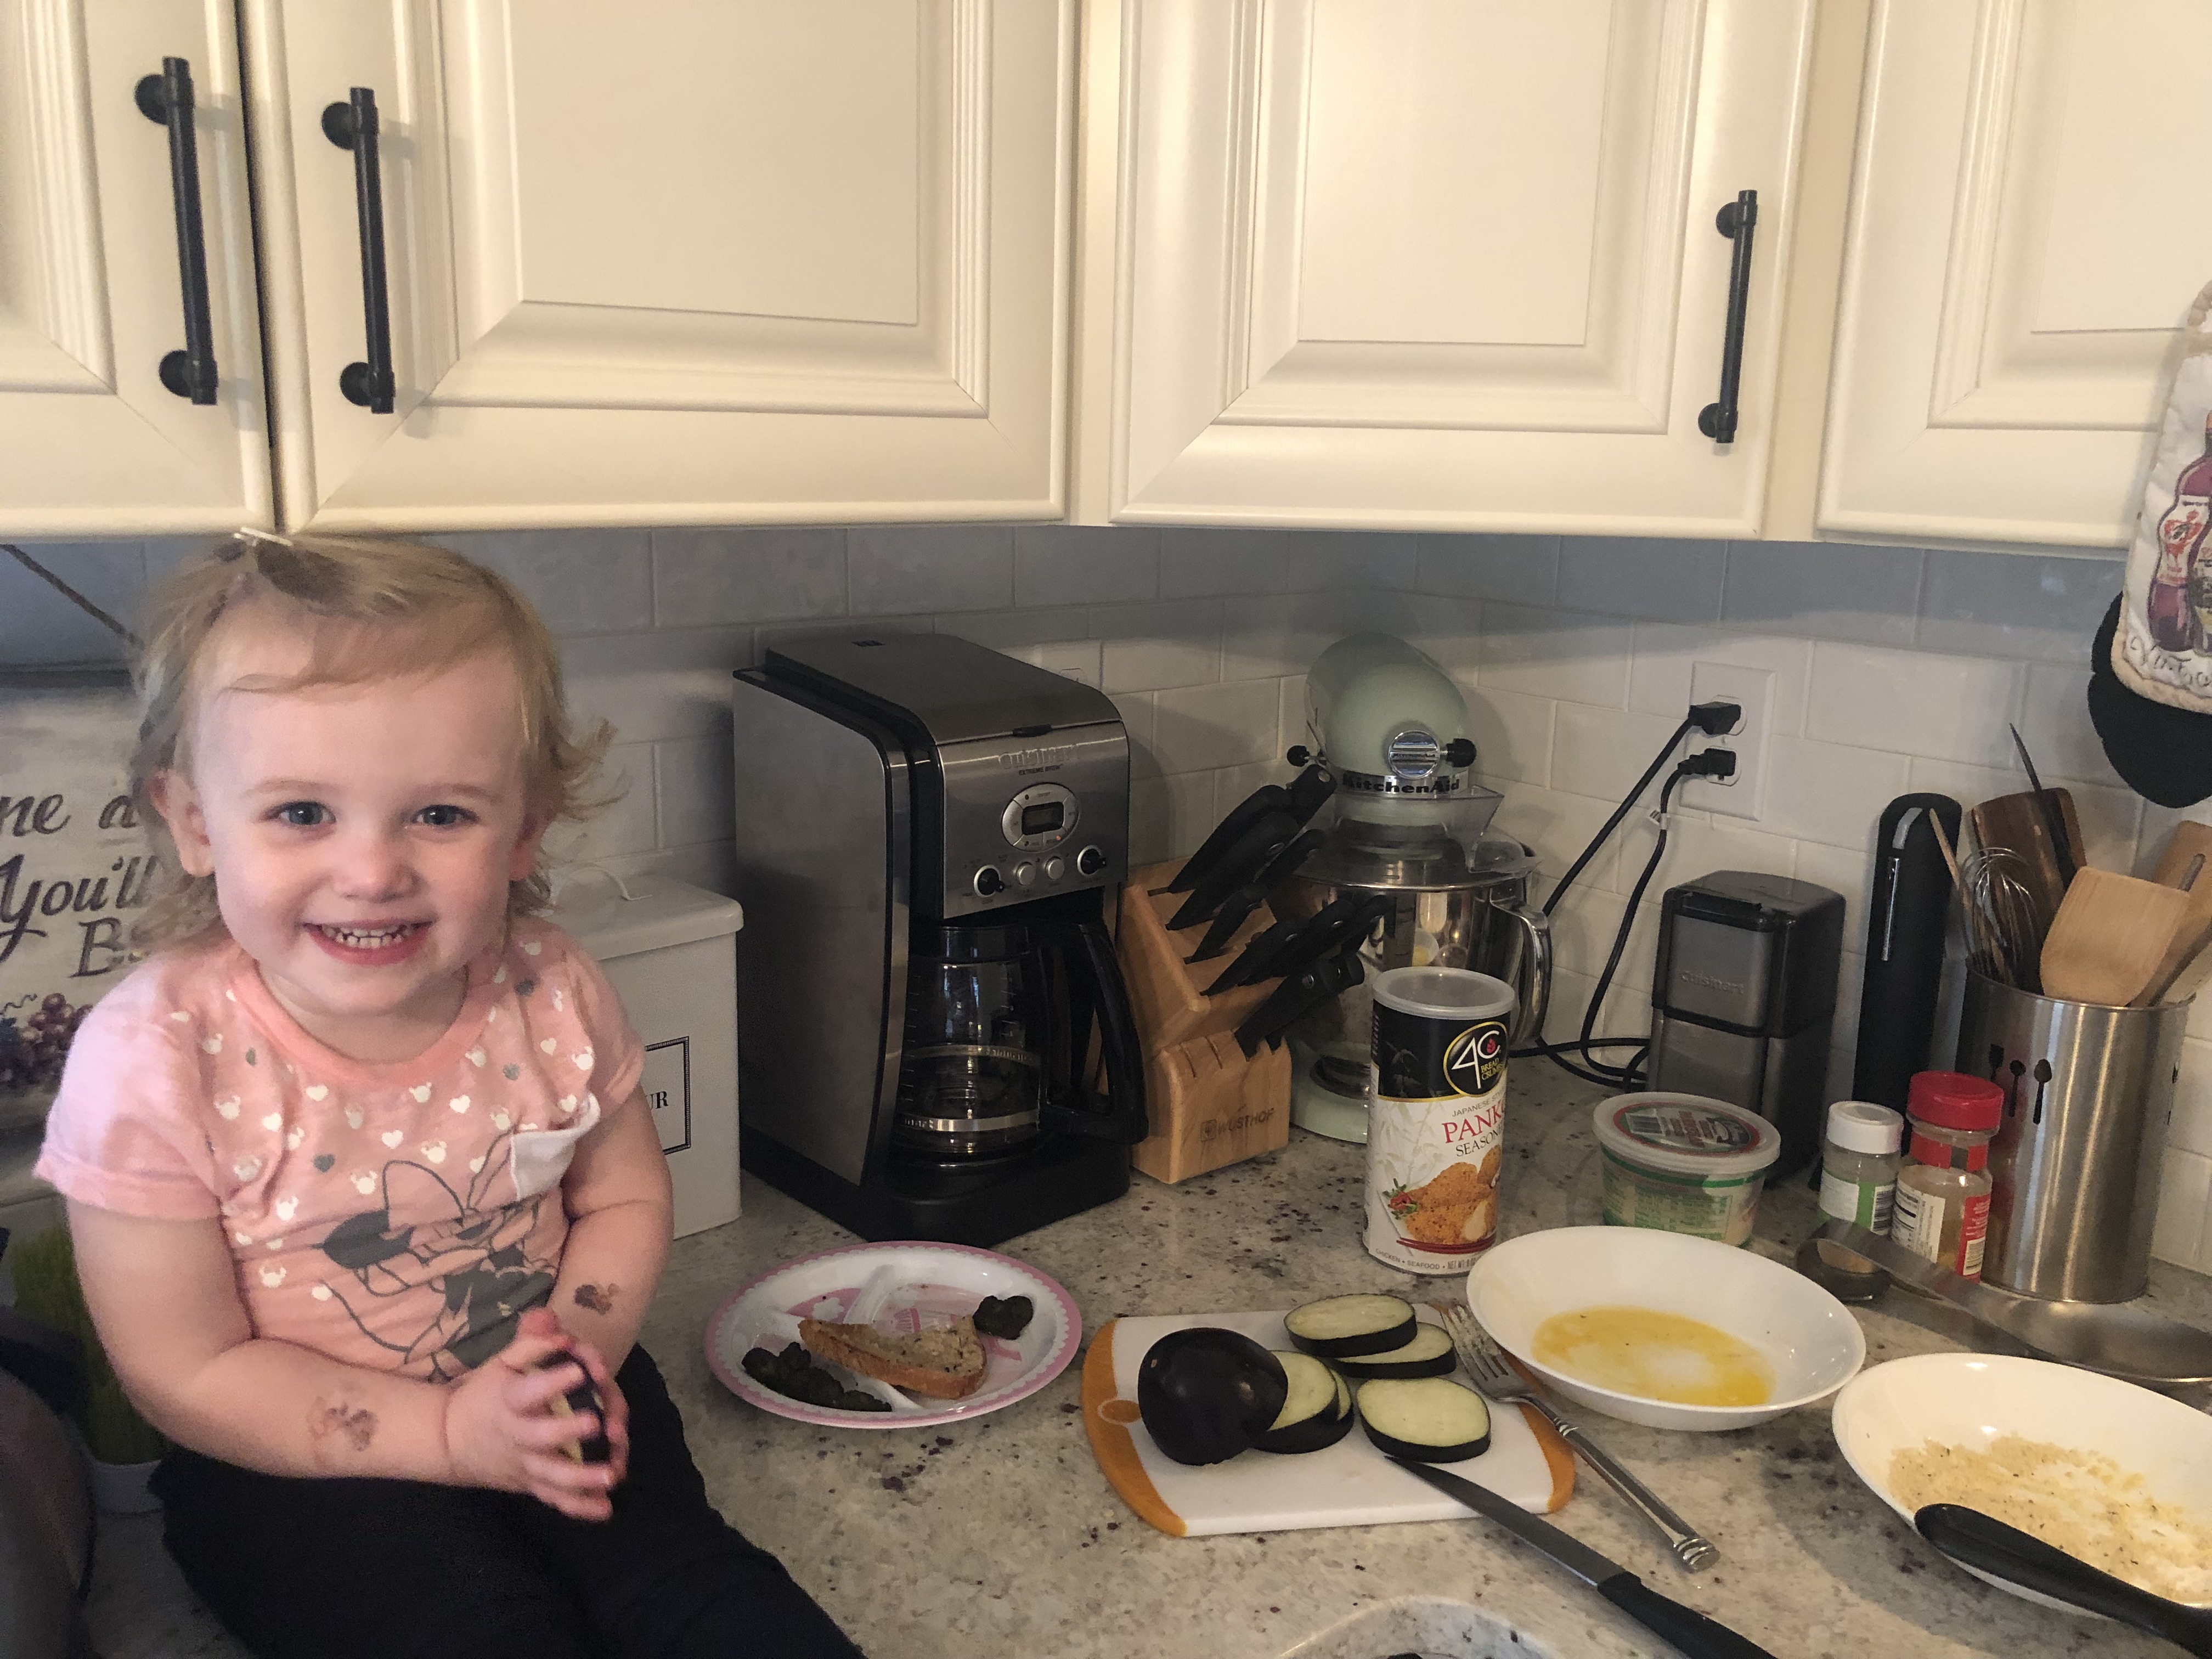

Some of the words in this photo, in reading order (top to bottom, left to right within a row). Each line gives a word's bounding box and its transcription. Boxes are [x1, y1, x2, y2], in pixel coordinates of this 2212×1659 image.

[1019, 768, 1044, 776] EXTREME
[1343, 772, 1459, 793] KitchenAid
[99, 795, 137, 829] a
[1451, 1030, 1500, 1089] 4C
[1481, 1058, 1499, 1073] BREAD
[1452, 1099, 1489, 1117] JAPANESE
[1407, 1260, 1441, 1270] SEAFOOD
